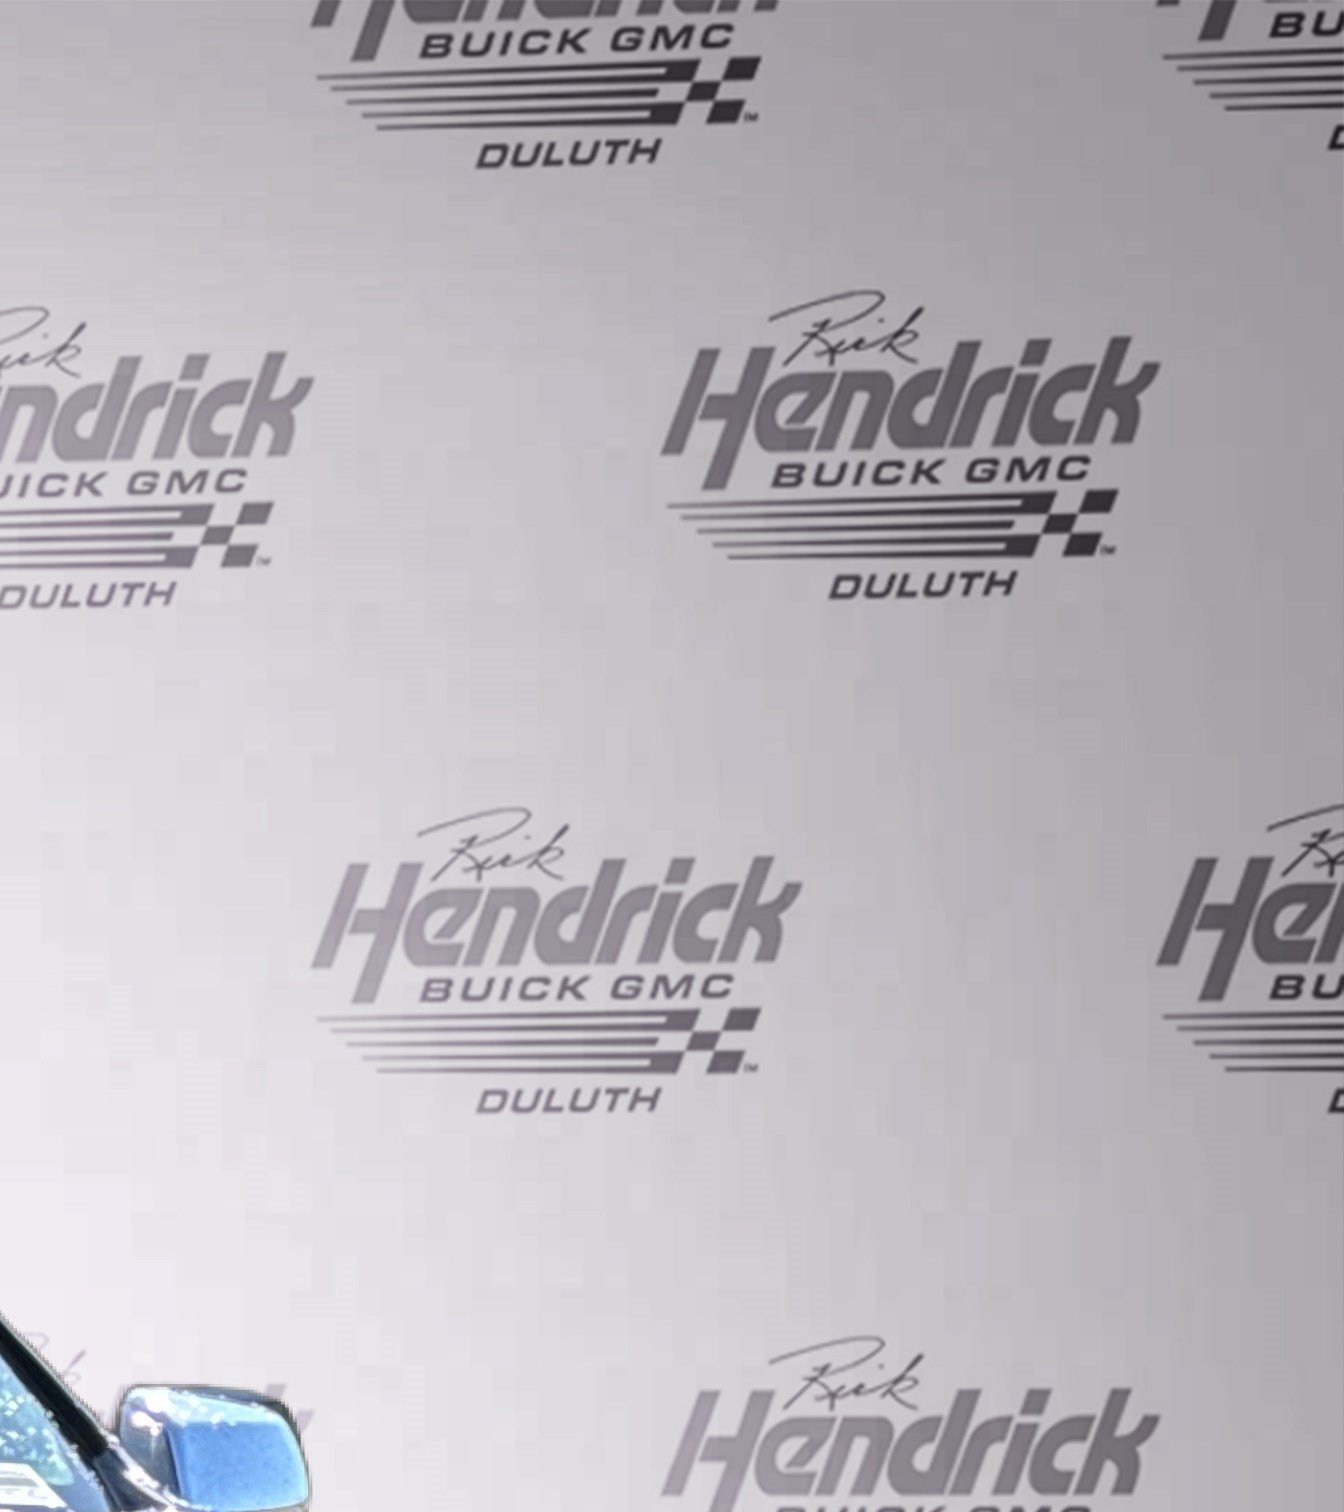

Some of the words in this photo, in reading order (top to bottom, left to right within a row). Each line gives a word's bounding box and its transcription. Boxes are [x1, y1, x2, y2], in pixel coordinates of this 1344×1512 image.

[419, 28, 593, 59] BUICK
[609, 24, 735, 52] GMC
[474, 138, 663, 169] DULUTH
[659, 335, 1162, 491] Hendrick
[125, 468, 248, 496] GMC
[769, 458, 946, 489] BUICK
[964, 455, 1092, 484] GMC
[828, 570, 1019, 600] DULUTH
[310, 855, 803, 1004] Hendrick
[418, 974, 592, 1003] BUICK
[608, 973, 735, 1001] GMC
[475, 1086, 663, 1115] DULUTH
